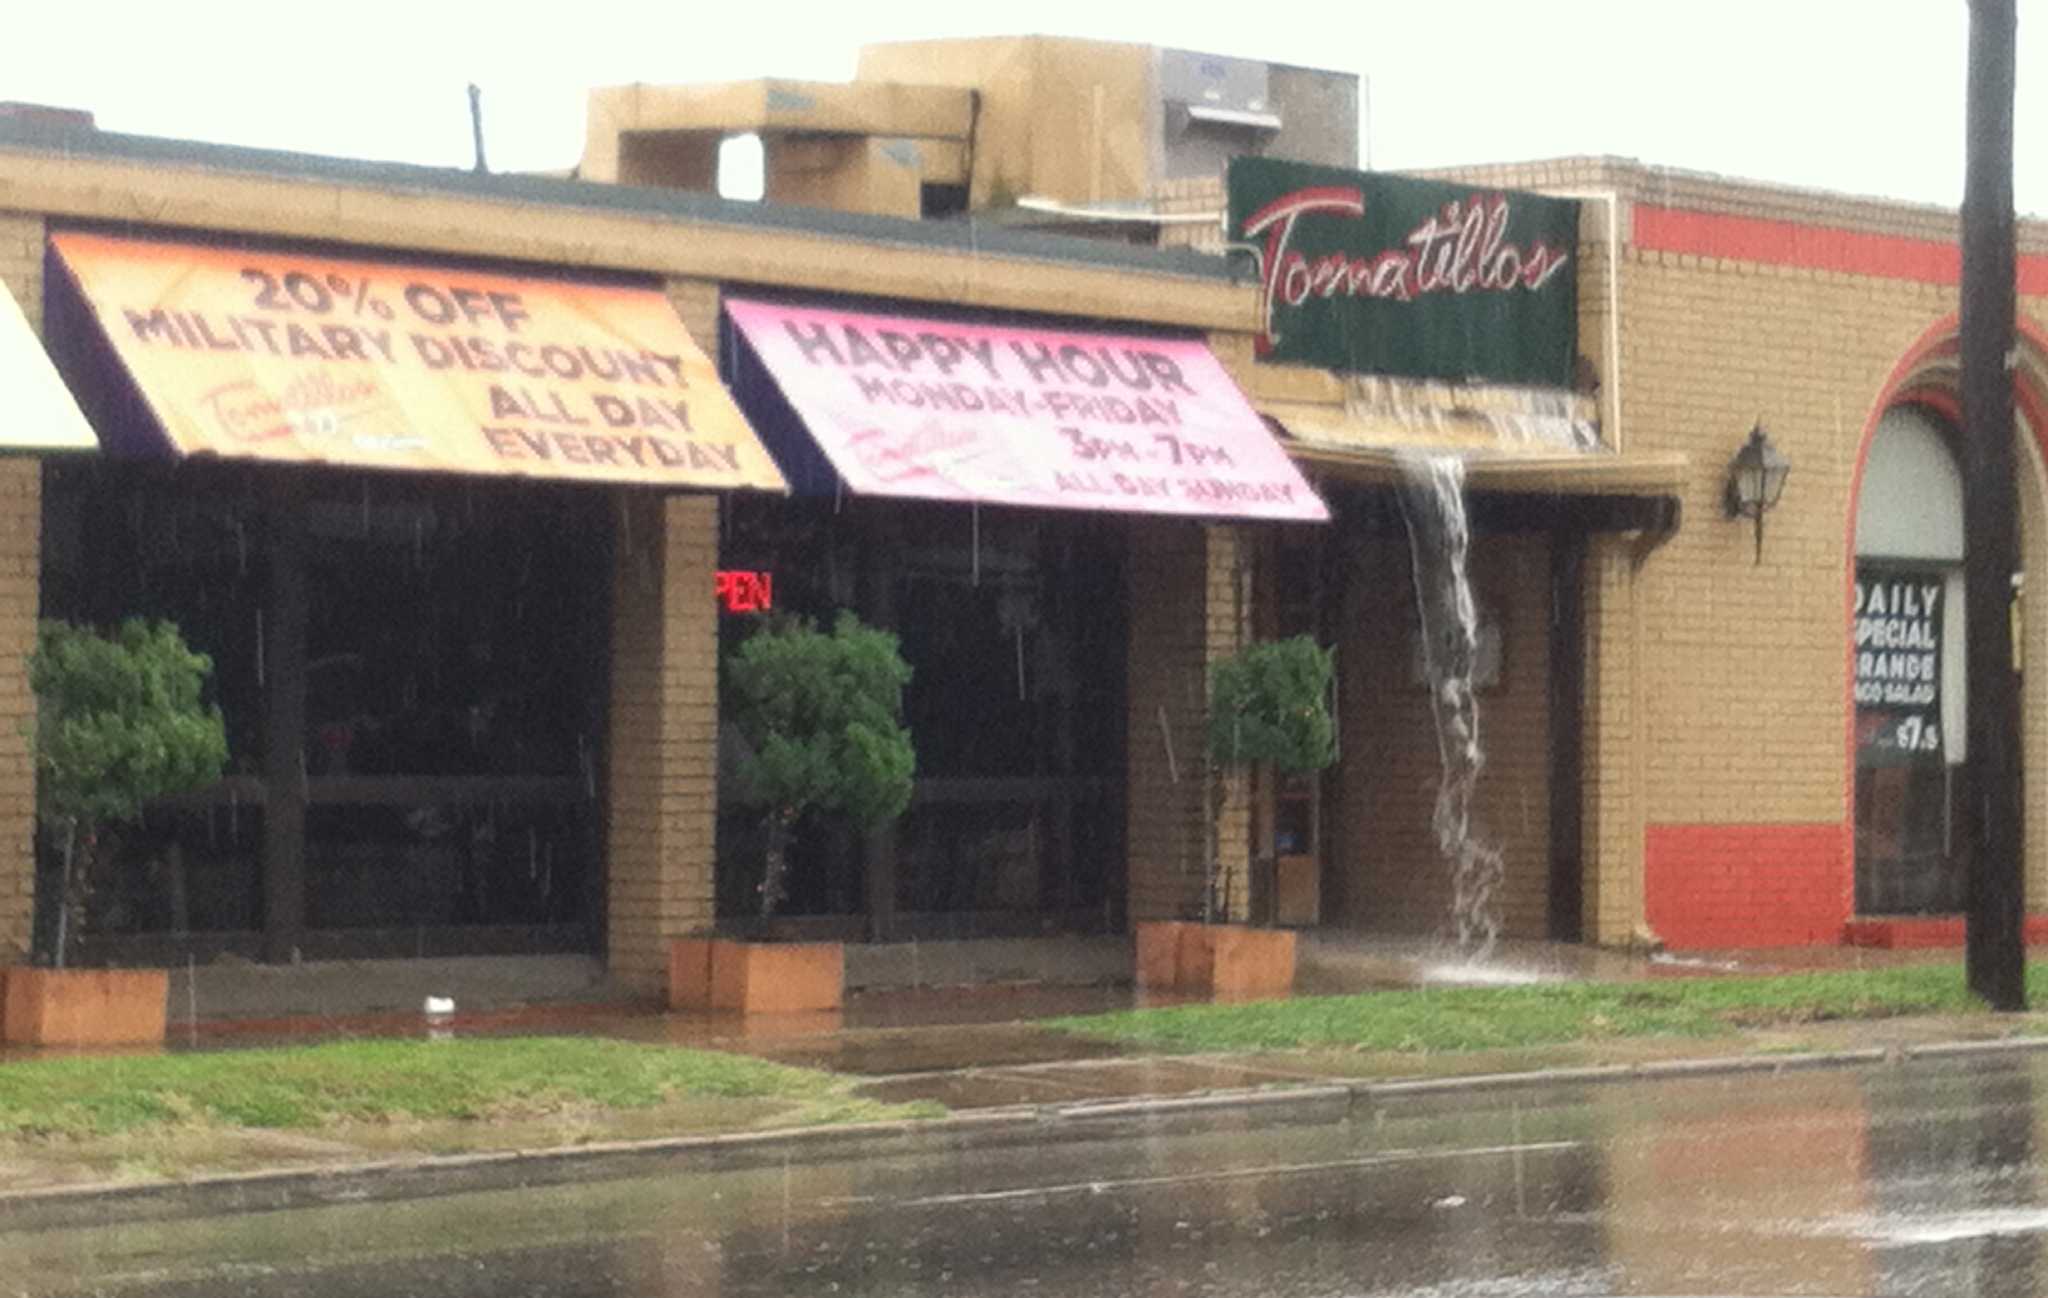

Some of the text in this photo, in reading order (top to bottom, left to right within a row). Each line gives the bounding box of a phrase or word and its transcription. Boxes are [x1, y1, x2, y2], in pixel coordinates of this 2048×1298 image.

[1242, 186, 1568, 356] Tomatillos
[240, 268, 530, 332] 20% OFF
[122, 306, 690, 389] MILITARY DISCOUNT
[780, 319, 1199, 396] HAPPY HOUR
[488, 384, 694, 432] ALL DAY
[481, 426, 740, 471] EVERYDAY
[1054, 470, 1114, 495] ALL
[1111, 472, 1172, 496] DAY
[715, 570, 772, 611] PEN
